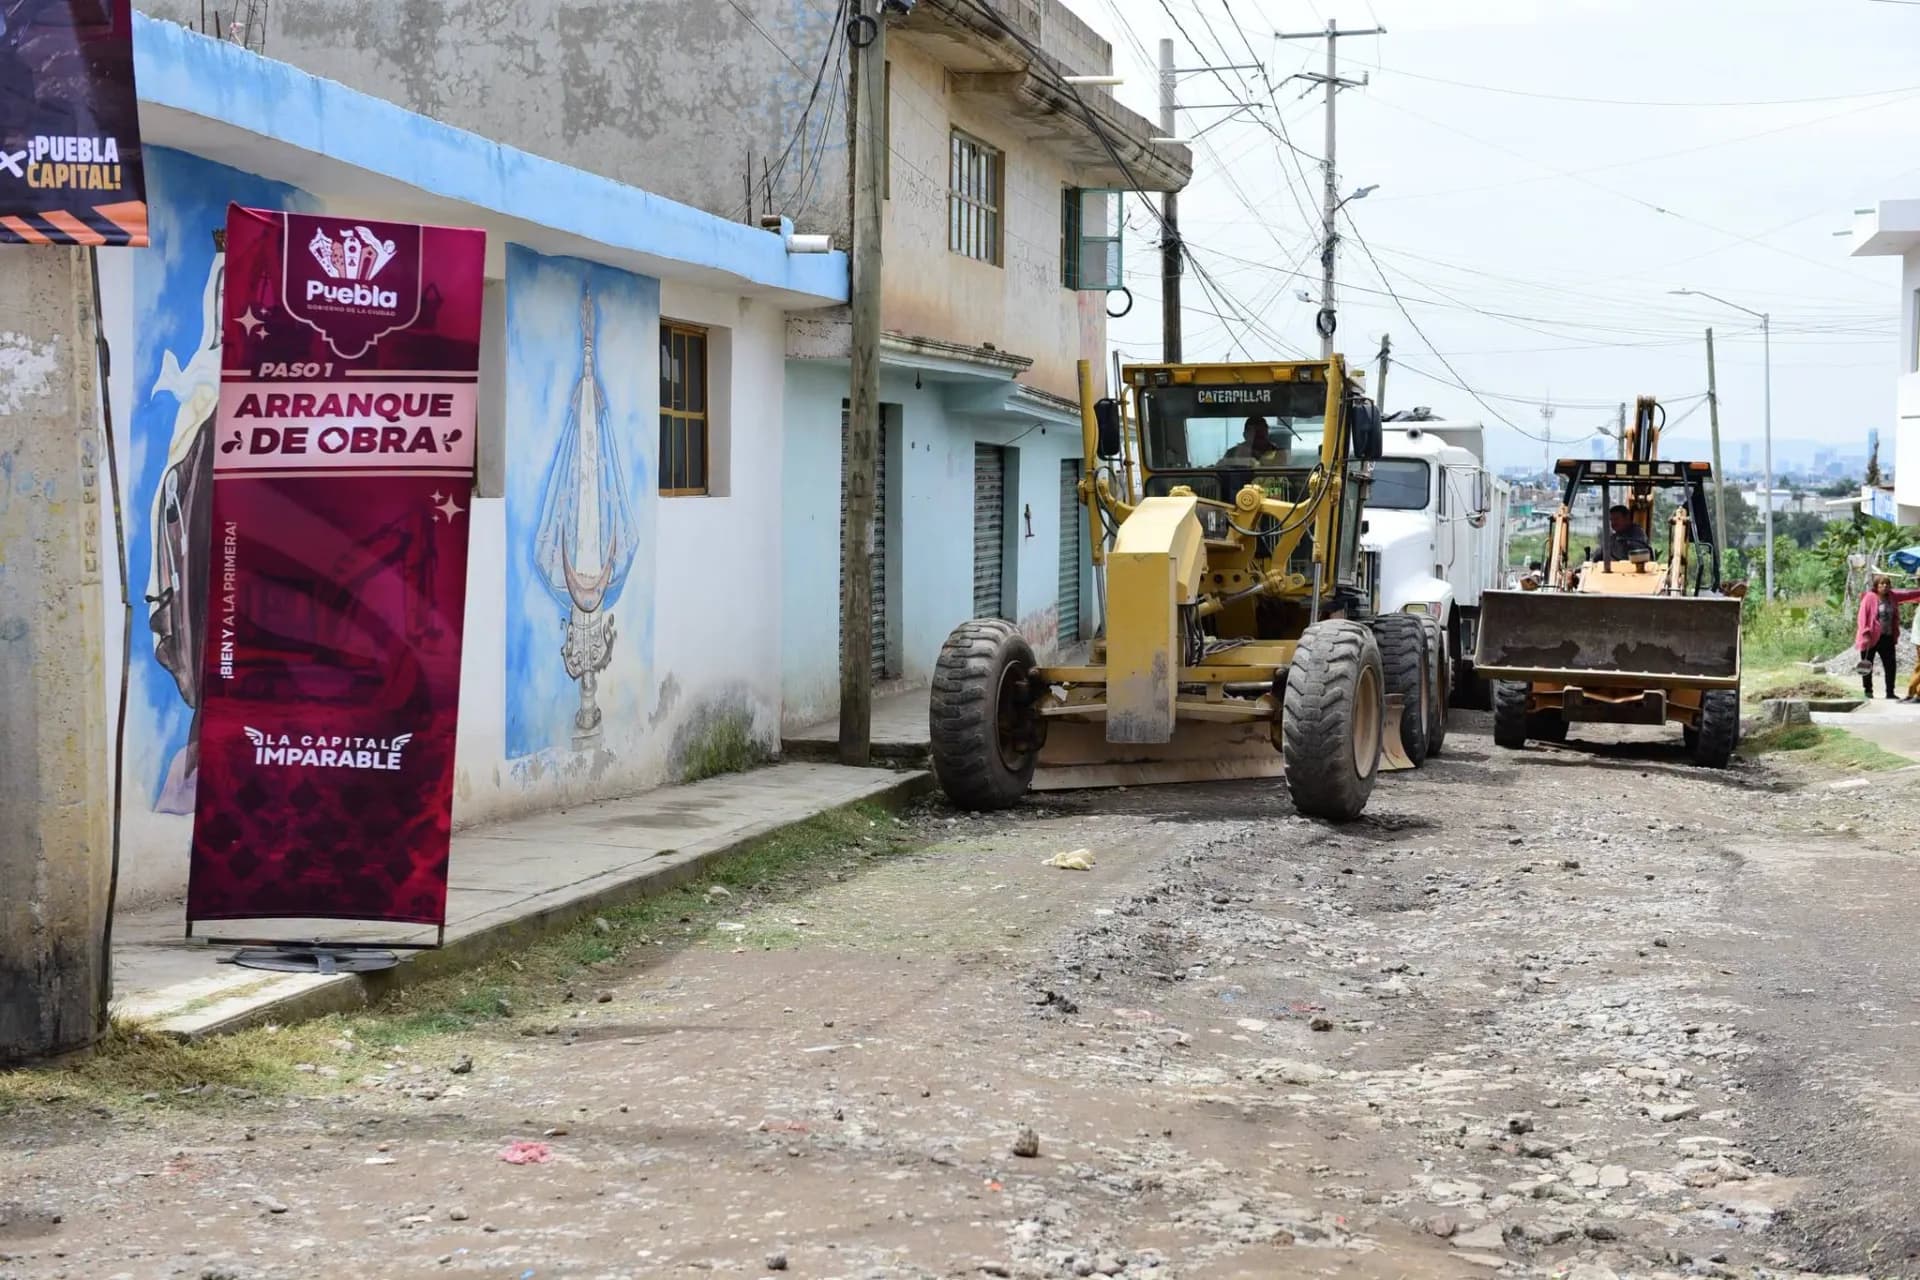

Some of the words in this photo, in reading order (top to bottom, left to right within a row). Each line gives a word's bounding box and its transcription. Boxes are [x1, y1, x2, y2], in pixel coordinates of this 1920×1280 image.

[27, 135, 120, 166] ¡PUEBLA
[26, 163, 122, 190] CAPITAL!
[306, 280, 398, 308] Puebla
[258, 362, 323, 378] PASO
[322, 362, 334, 378] 1
[233, 392, 454, 423] ARRANQUE
[1198, 389, 1272, 403] CATERPILLAR
[249, 426, 309, 455] DE
[316, 426, 438, 455] OBRA
[223, 521, 237, 591] PRIMERA!
[223, 594, 236, 612] LA
[222, 615, 235, 627] A
[221, 628, 235, 640] Y
[220, 641, 235, 679] ¡BIEN
[266, 733, 291, 746] LA
[301, 735, 390, 750] CAPITAL
[255, 747, 402, 770] IMPARABLE
